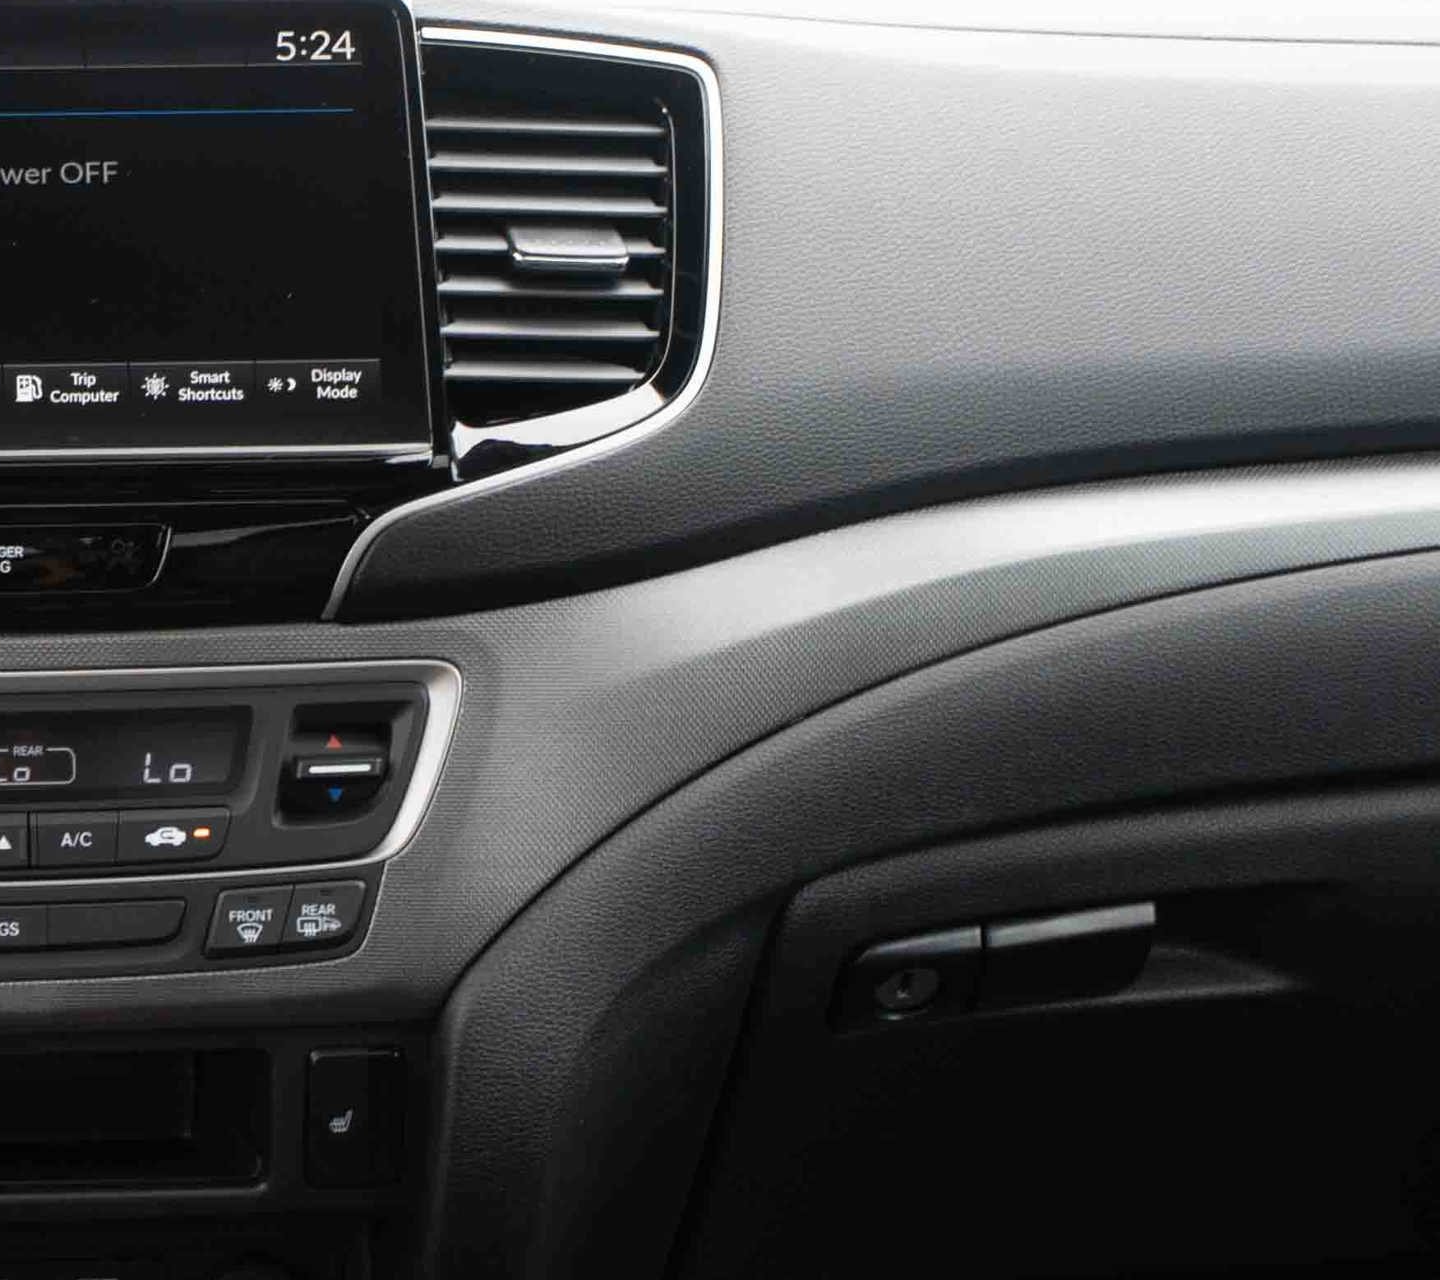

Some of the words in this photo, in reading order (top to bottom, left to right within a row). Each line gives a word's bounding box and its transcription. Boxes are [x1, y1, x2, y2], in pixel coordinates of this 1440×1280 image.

[274, 30, 356, 61] 5:24
[59, 161, 119, 185] OFF
[70, 373, 96, 388] Trip
[190, 371, 231, 385] Smart
[311, 368, 363, 384] Display
[50, 390, 119, 406] Computer
[178, 387, 245, 402] Shortcuts
[316, 385, 358, 399] Mode
[13, 745, 44, 756] REAR
[60, 830, 93, 849] A/C
[228, 908, 273, 922] FRONT
[301, 903, 336, 916] REAR
